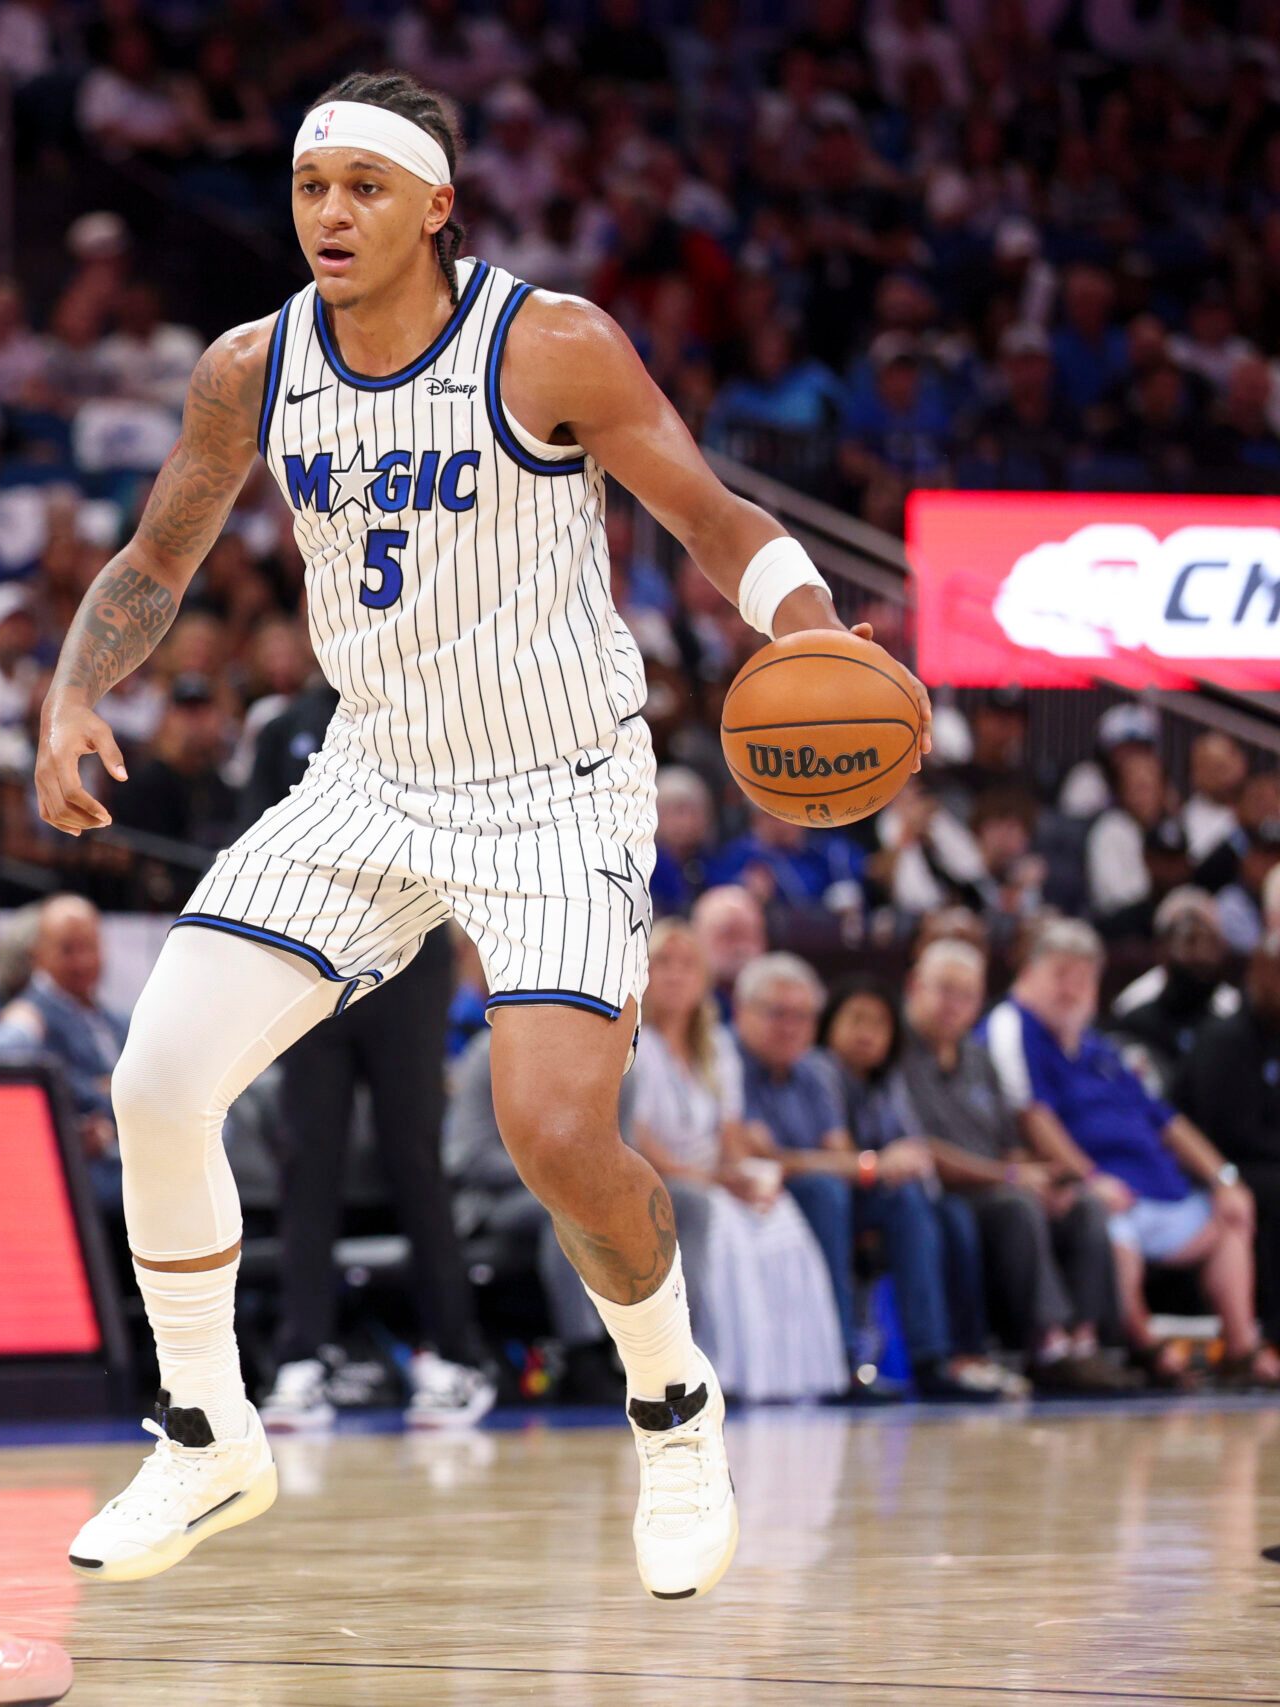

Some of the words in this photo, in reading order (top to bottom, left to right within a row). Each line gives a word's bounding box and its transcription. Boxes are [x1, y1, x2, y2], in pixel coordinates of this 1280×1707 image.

[424, 377, 478, 400] Disney
[359, 528, 410, 610] 5
[746, 742, 881, 779] Wilson
